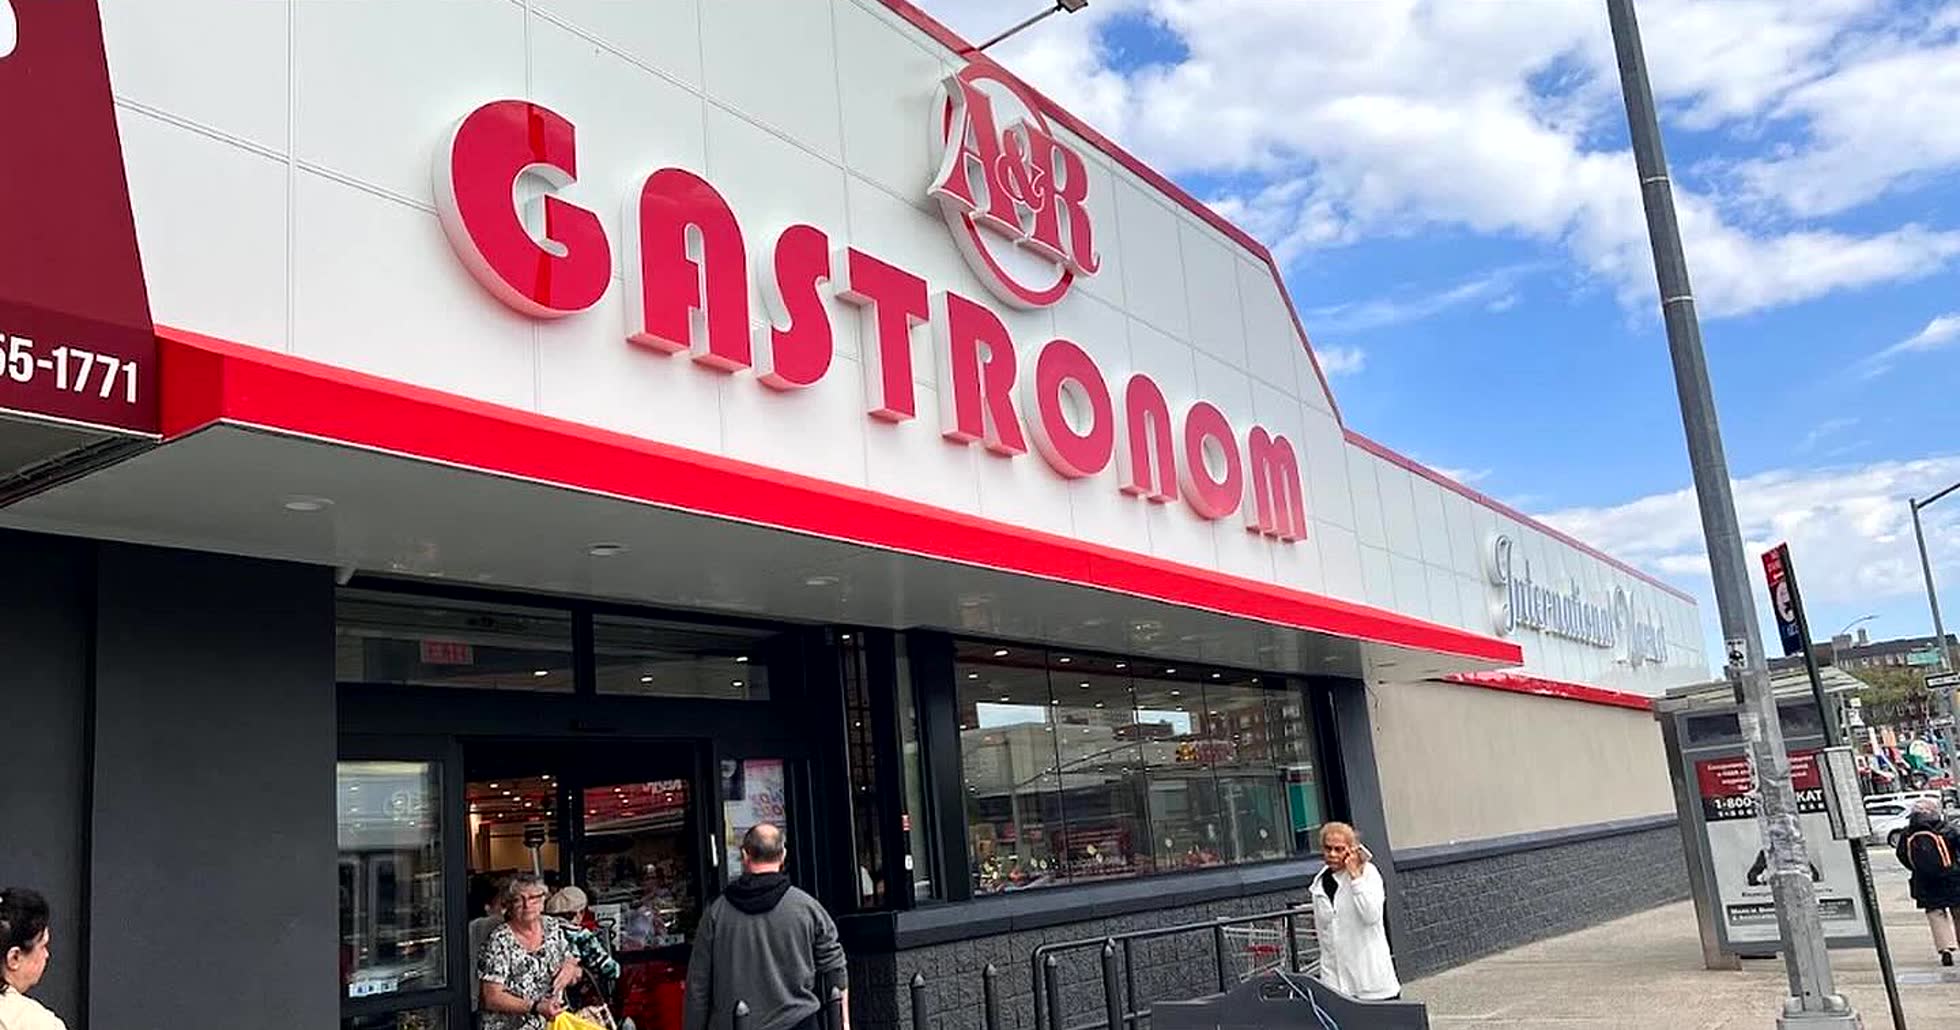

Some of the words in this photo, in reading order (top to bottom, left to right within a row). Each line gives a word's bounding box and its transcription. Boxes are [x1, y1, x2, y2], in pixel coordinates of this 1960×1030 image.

[927, 72, 1101, 277] A&R
[0, 333, 137, 404] 5-1771
[434, 99, 1307, 542] GASTRONOM
